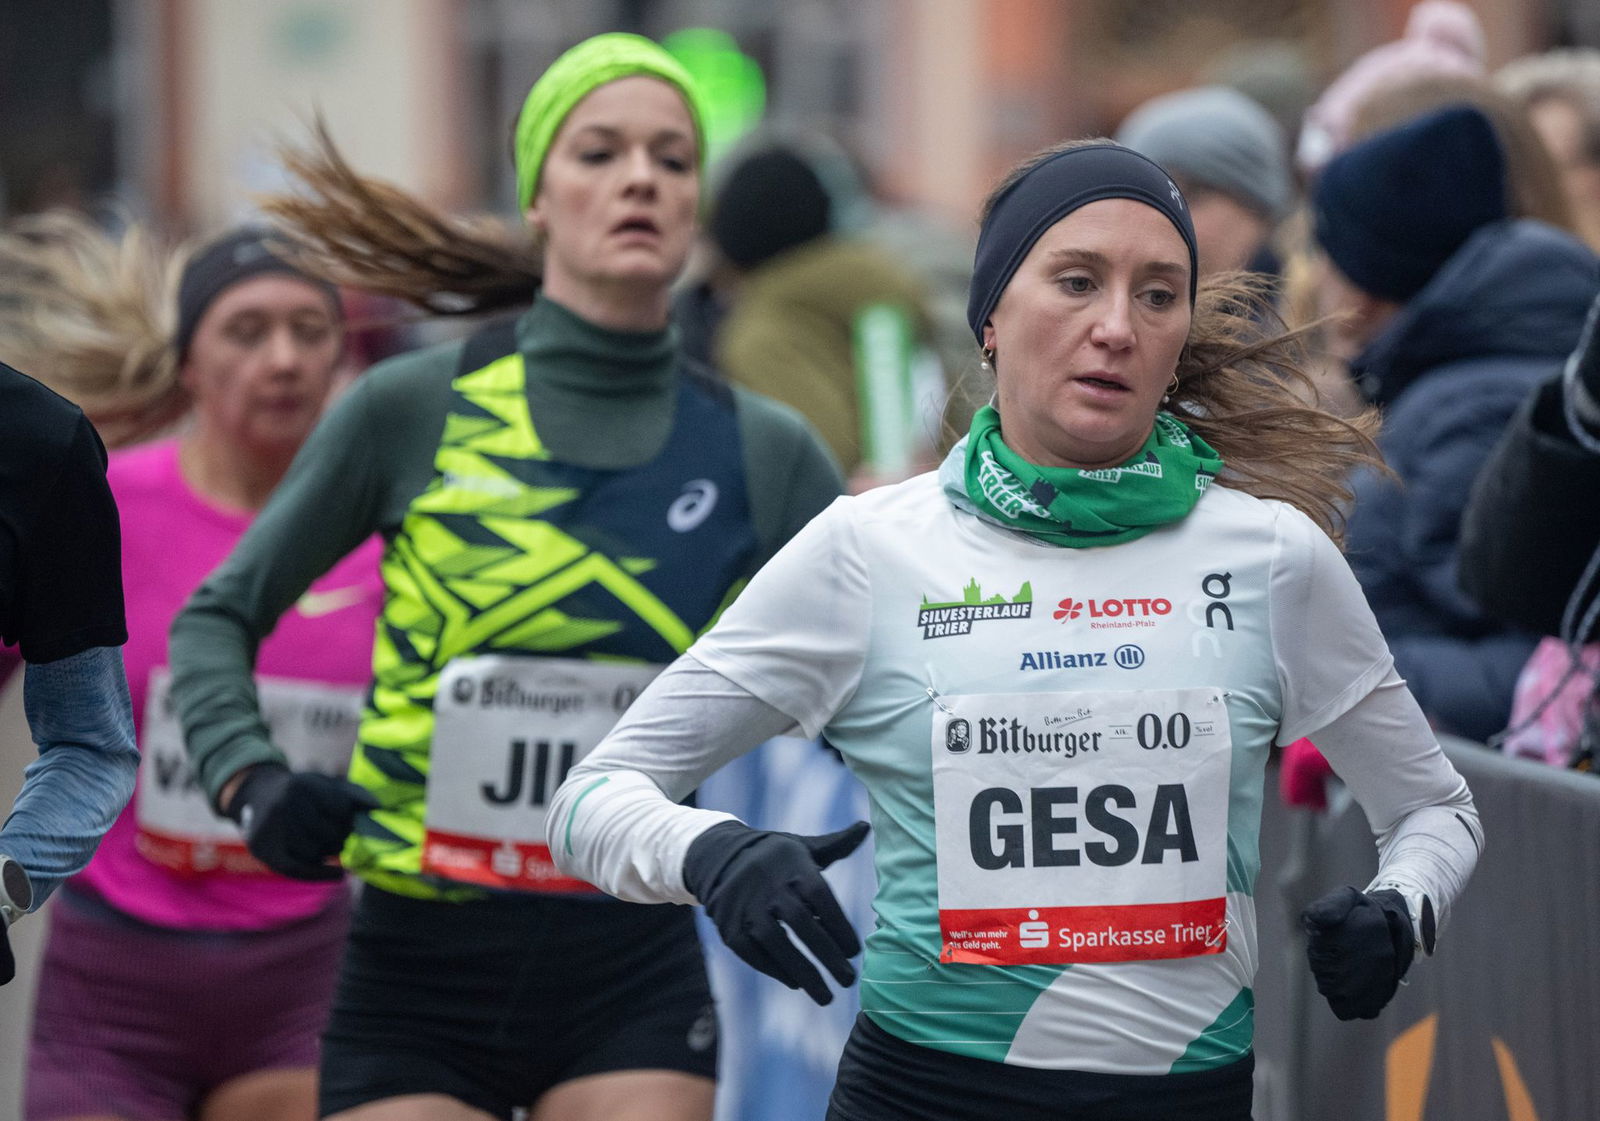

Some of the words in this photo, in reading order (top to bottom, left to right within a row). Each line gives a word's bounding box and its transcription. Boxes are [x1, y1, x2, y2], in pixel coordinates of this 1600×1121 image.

[920, 603, 1030, 624] SILVESTERLAUF
[1088, 598, 1172, 618] LOTTO
[927, 621, 969, 637] TRIER
[1090, 620, 1156, 630] Rheinland-Pfalz
[1020, 651, 1108, 671] Allianz
[977, 716, 1103, 758] Bitburger
[1137, 712, 1191, 750] 0.0
[969, 783, 1200, 870] GESA
[949, 930, 973, 939] Weil's
[974, 931, 986, 939] um
[988, 929, 1008, 939] mehr
[1058, 926, 1166, 952] Sparkasse
[1171, 922, 1212, 943] Trier
[963, 941, 980, 950] Geld
[981, 941, 1002, 952] geht.
